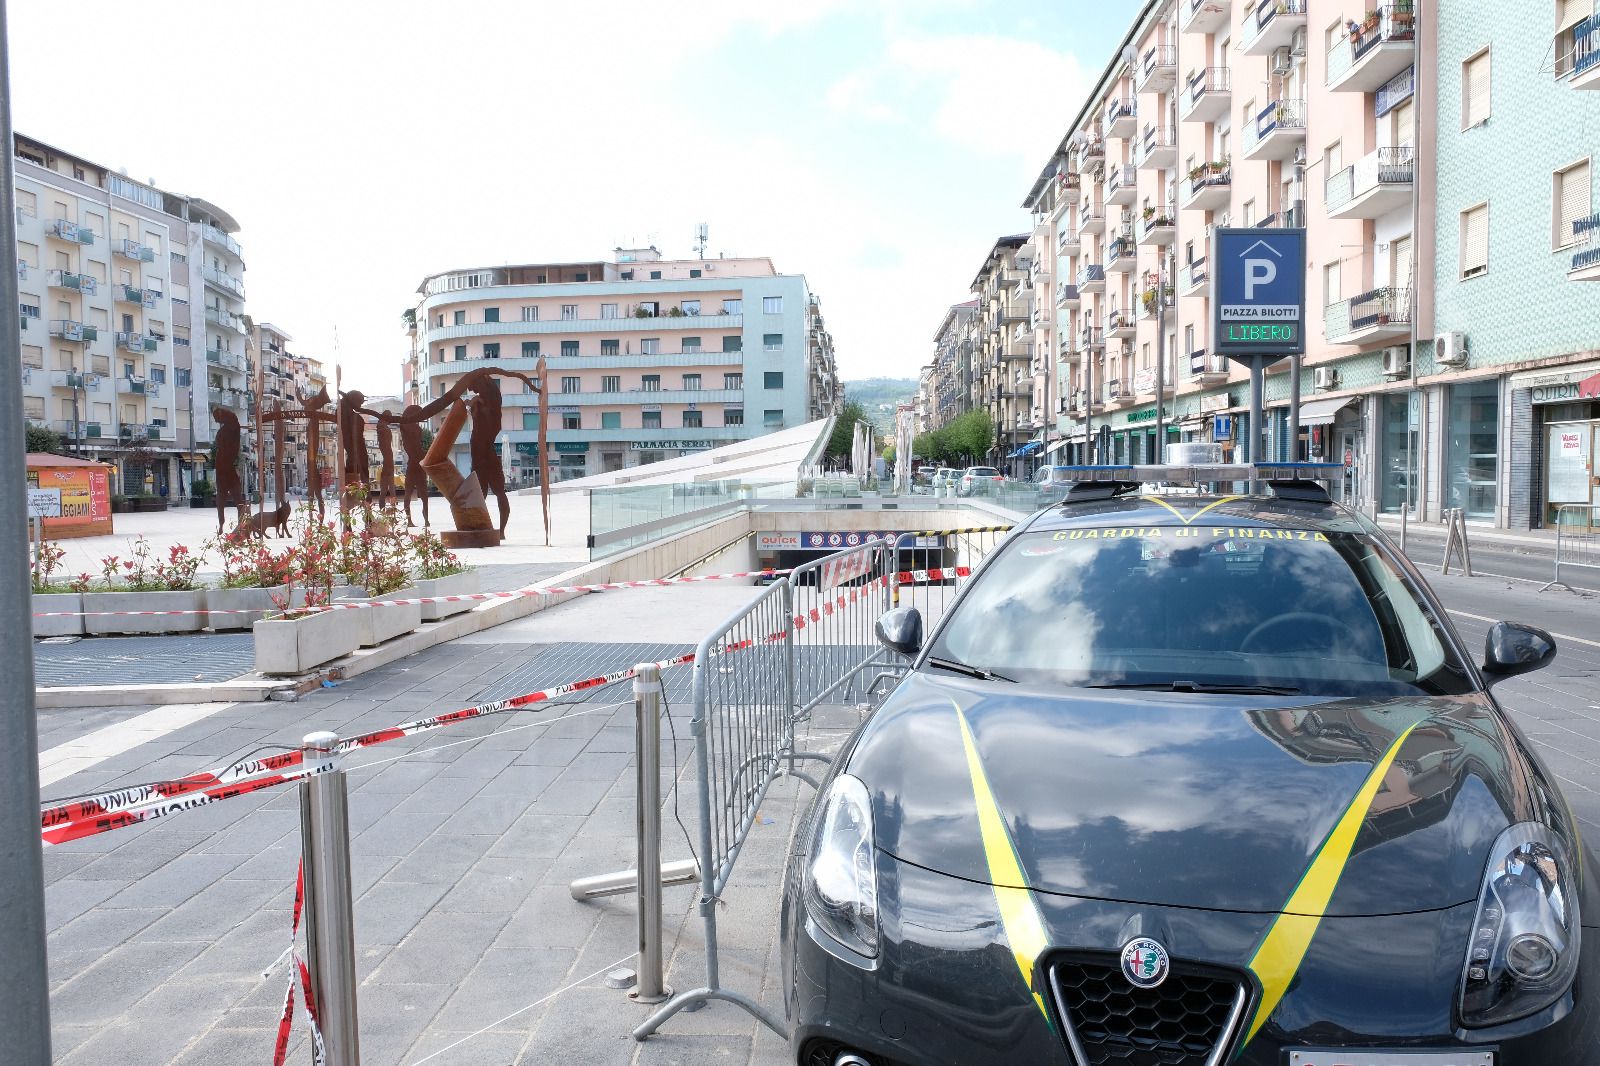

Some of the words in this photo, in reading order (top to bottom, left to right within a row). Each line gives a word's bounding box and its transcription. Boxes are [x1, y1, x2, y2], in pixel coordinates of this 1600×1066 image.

[1244, 258, 1277, 300] P
[1223, 308, 1258, 317] PIAZZA
[1261, 308, 1296, 317] BILOTTI
[1229, 325, 1291, 340] LIBERO
[1532, 384, 1581, 401] QUIRIN
[631, 440, 679, 449] FARMACIA
[681, 439, 712, 448] SERRA
[761, 534, 798, 544] QUICK
[1052, 528, 1162, 541] GUARDIA
[1175, 527, 1198, 537] di
[1213, 527, 1329, 543] FINANZA
[80, 782, 189, 817] MUNICIPALE
[233, 752, 293, 778] POLIZIA
[1125, 944, 1140, 961] ALFA
[1143, 942, 1165, 967] ROMEO
